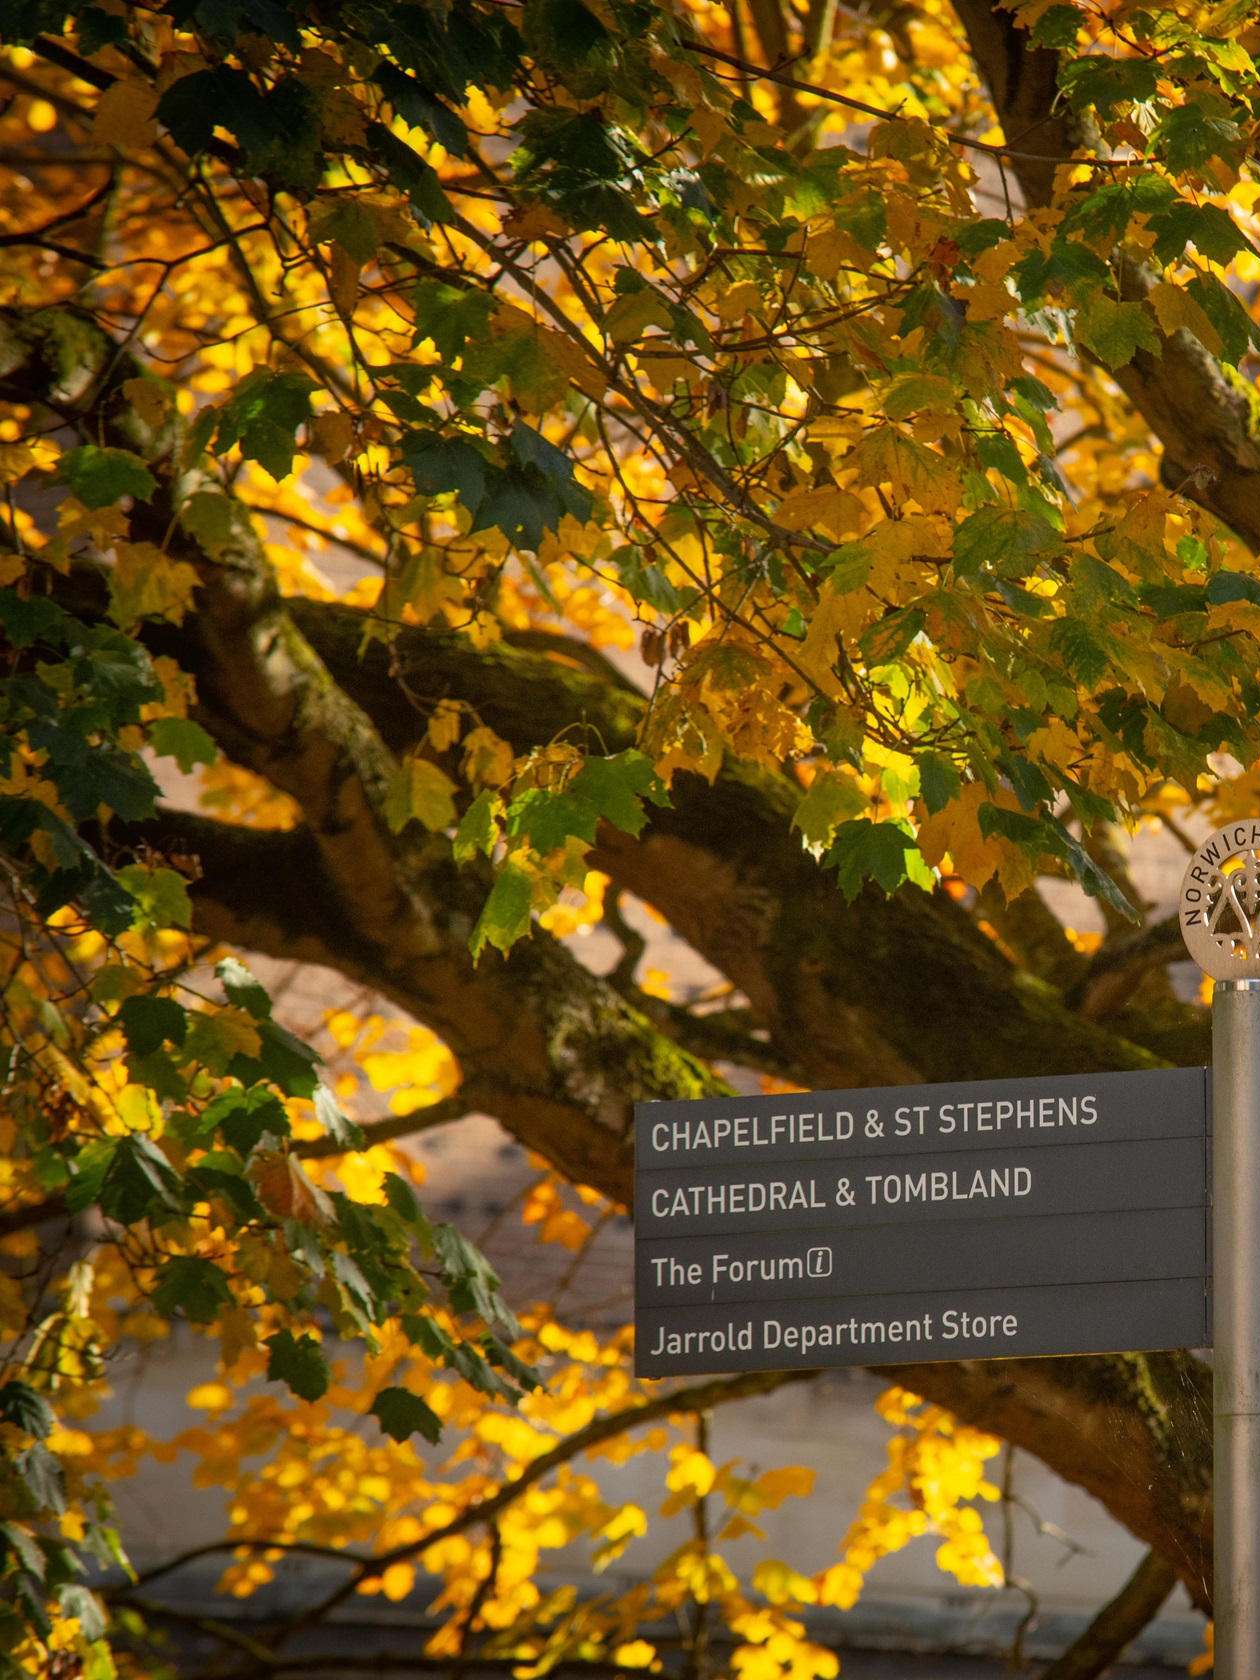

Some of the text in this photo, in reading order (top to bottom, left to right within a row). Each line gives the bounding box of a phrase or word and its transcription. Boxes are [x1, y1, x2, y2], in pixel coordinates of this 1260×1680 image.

[652, 1095, 1098, 1152] CHAPELFIELD & ST STEPHENS
[652, 1167, 1032, 1218] CATHEDRAL & TOMBLAND
[651, 1257, 702, 1287] The
[712, 1254, 803, 1283] Forum
[650, 1310, 1018, 1355] Jarrold Department Store
